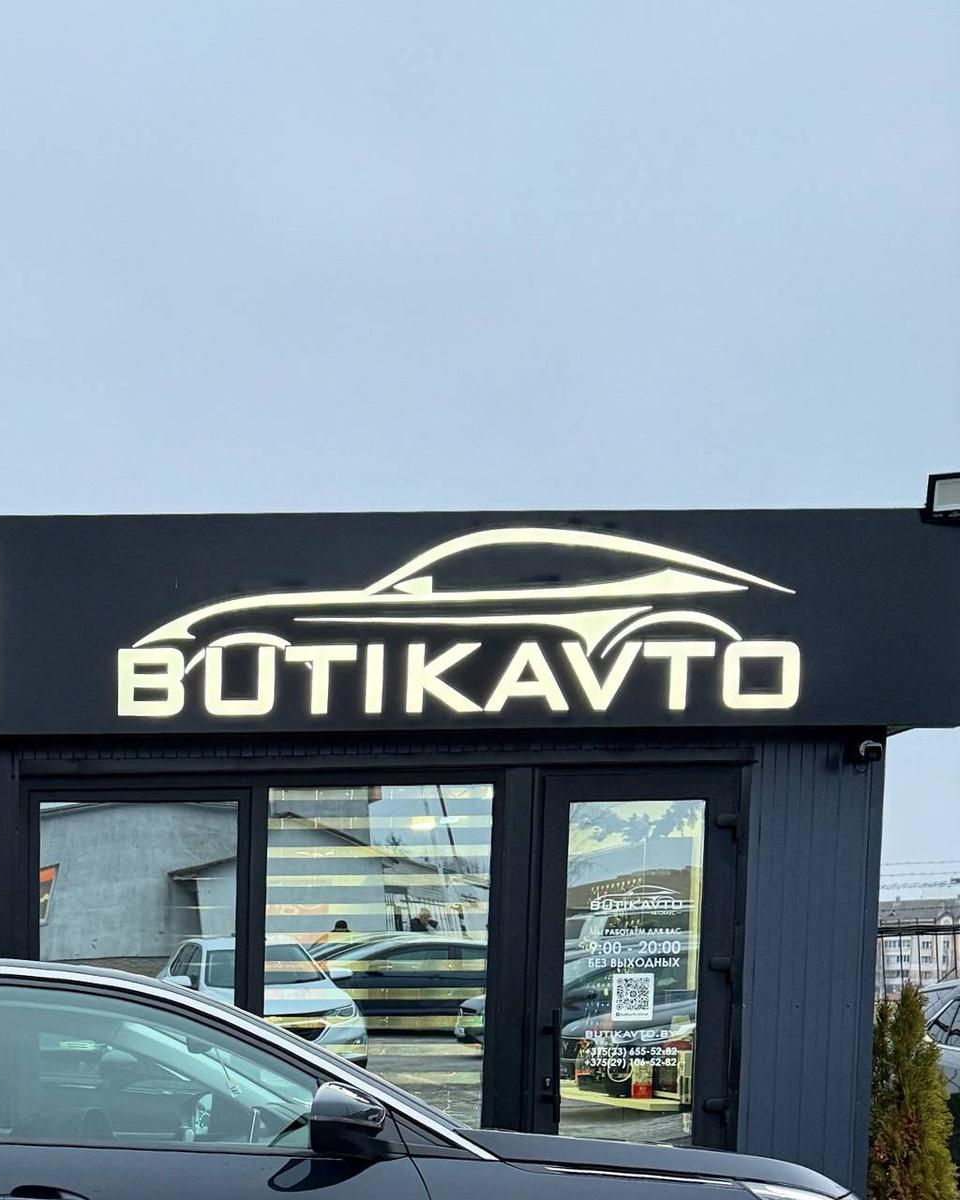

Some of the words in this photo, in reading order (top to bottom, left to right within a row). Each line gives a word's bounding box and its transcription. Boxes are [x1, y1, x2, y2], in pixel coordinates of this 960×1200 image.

[117, 640, 801, 717] BUTIKAVTO
[590, 899, 682, 911] BUTIKAVTO
[605, 928, 645, 936] РАБОТАЕМ
[590, 941, 621, 955] 9:00
[638, 941, 681, 954] 20:00
[588, 958, 607, 968] БЕЗ
[610, 957, 680, 968] ВЫХОДНЫХ
[629, 1047, 677, 1056] 655-52-82
[585, 1058, 627, 1068] +375(29)
